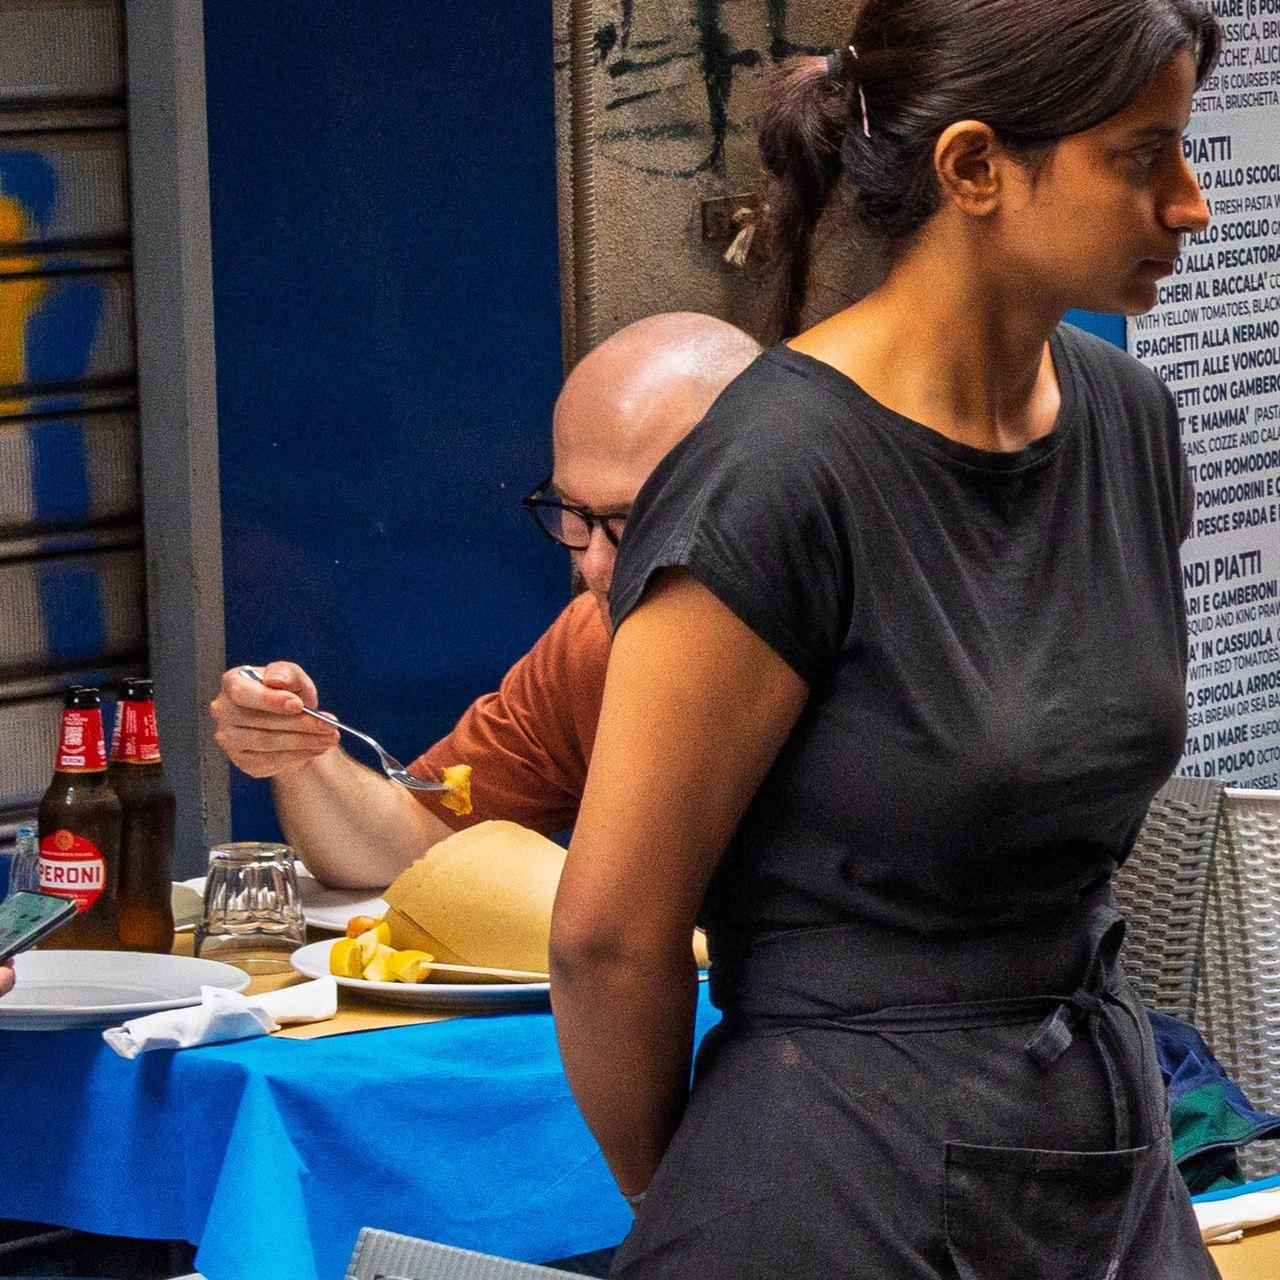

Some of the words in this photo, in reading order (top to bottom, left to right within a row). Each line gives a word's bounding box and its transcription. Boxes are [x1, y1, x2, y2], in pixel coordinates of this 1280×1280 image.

[1211, 0, 1242, 18] MARE
[1246, 0, 1256, 17] (6
[1254, 45, 1280, 64] ALICI
[1230, 72, 1268, 89] COURSES
[1225, 91, 1278, 109] BRUSCHETTA
[1182, 135, 1232, 164] PIATTI
[1214, 167, 1243, 188] ALLO
[1214, 197, 1242, 216] FRESH
[1244, 194, 1272, 212] PASTA
[1189, 228, 1218, 247] ALLO
[1221, 221, 1269, 243] SCOGLIO
[1186, 253, 1214, 273] ALLA
[1195, 281, 1209, 300] AL
[1212, 273, 1266, 297] BACCALA'
[1162, 307, 1198, 327] YELLOW
[1201, 300, 1251, 321] TOMATOES,
[1252, 296, 1280, 314] BLACK
[1136, 332, 1198, 359] SPAGHETTI
[1201, 328, 1230, 349] ALLA
[1232, 321, 1279, 344] NERANO
[1202, 356, 1229, 375] ALLE
[1202, 382, 1227, 403] CON
[1201, 407, 1248, 432] MAMMA'
[1208, 433, 1237, 453] COZZE
[1199, 460, 1222, 481] CON
[1197, 480, 1264, 510] POMODORINI
[1197, 513, 1229, 537] PESCE
[1232, 506, 1267, 530] SPADA
[1214, 549, 1262, 583] PIATTI
[1212, 580, 1277, 610] GAMBERONI
[1201, 638, 1213, 659] IN
[1215, 626, 1272, 656] CASSUOLA
[1214, 657, 1230, 676] RED
[1233, 646, 1280, 671] TOMATOES,
[1197, 679, 1243, 706] SPIGOLA
[1205, 703, 1234, 725] BREAM
[1251, 695, 1266, 714] SEA
[1217, 726, 1247, 749] MARE
[1203, 759, 1215, 777] DI
[1217, 750, 1255, 773] POLPO
